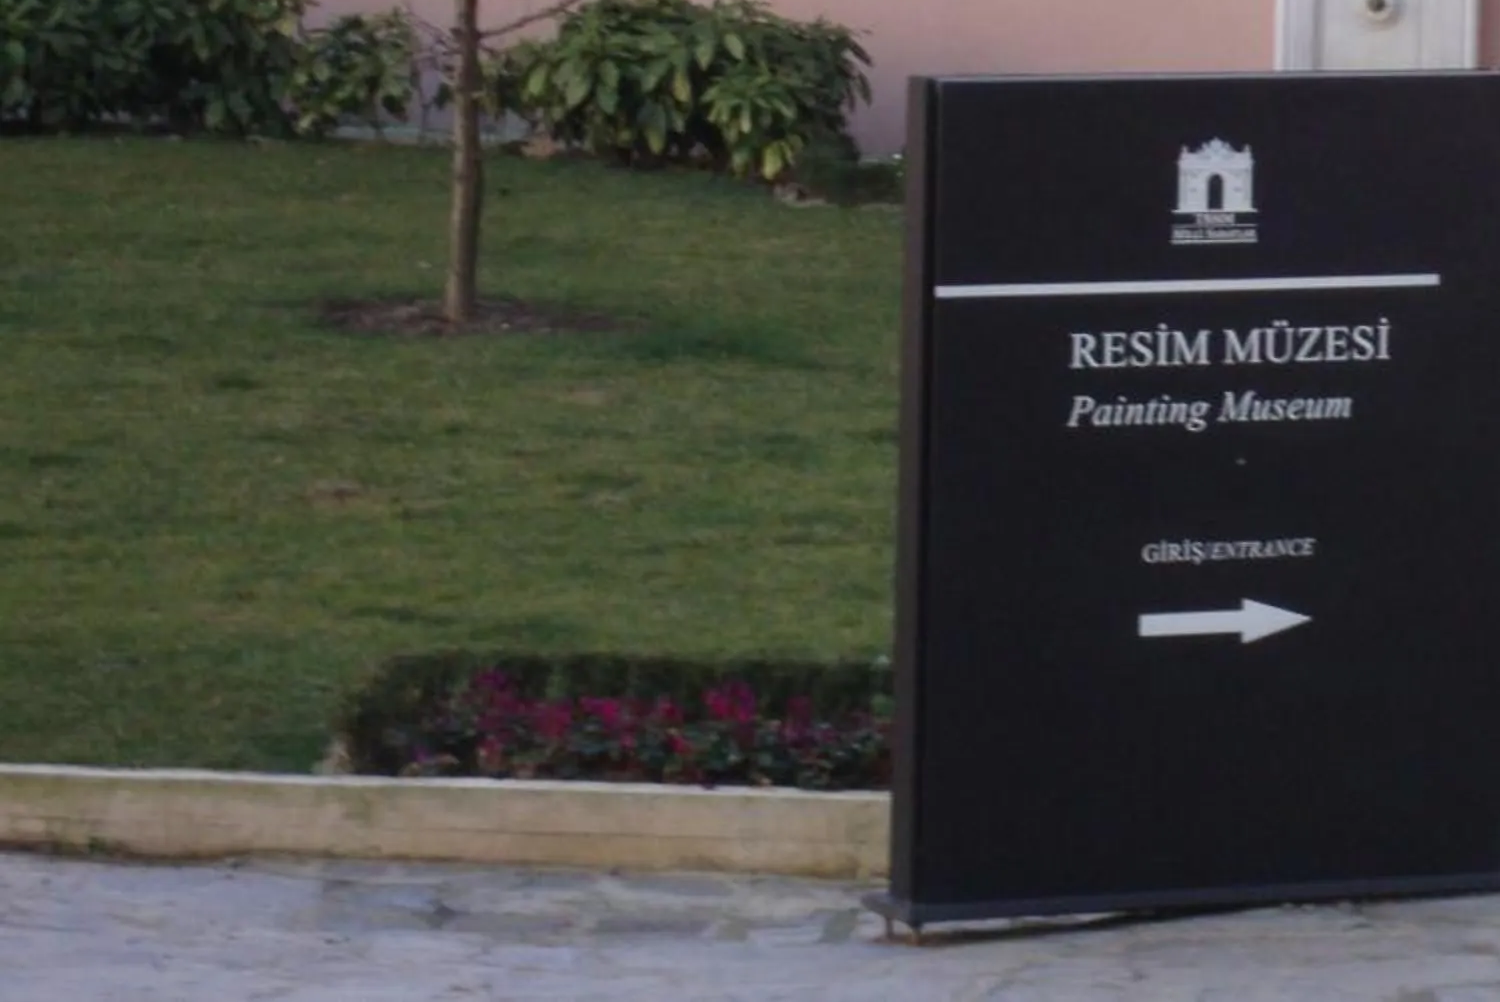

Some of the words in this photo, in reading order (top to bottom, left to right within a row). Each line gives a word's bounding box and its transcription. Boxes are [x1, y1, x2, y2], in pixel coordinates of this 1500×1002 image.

[1069, 323, 1210, 369] RESİM
[1222, 317, 1391, 364] MÜZESİ
[1066, 394, 1210, 432] Painting
[1216, 390, 1353, 422] Museum
